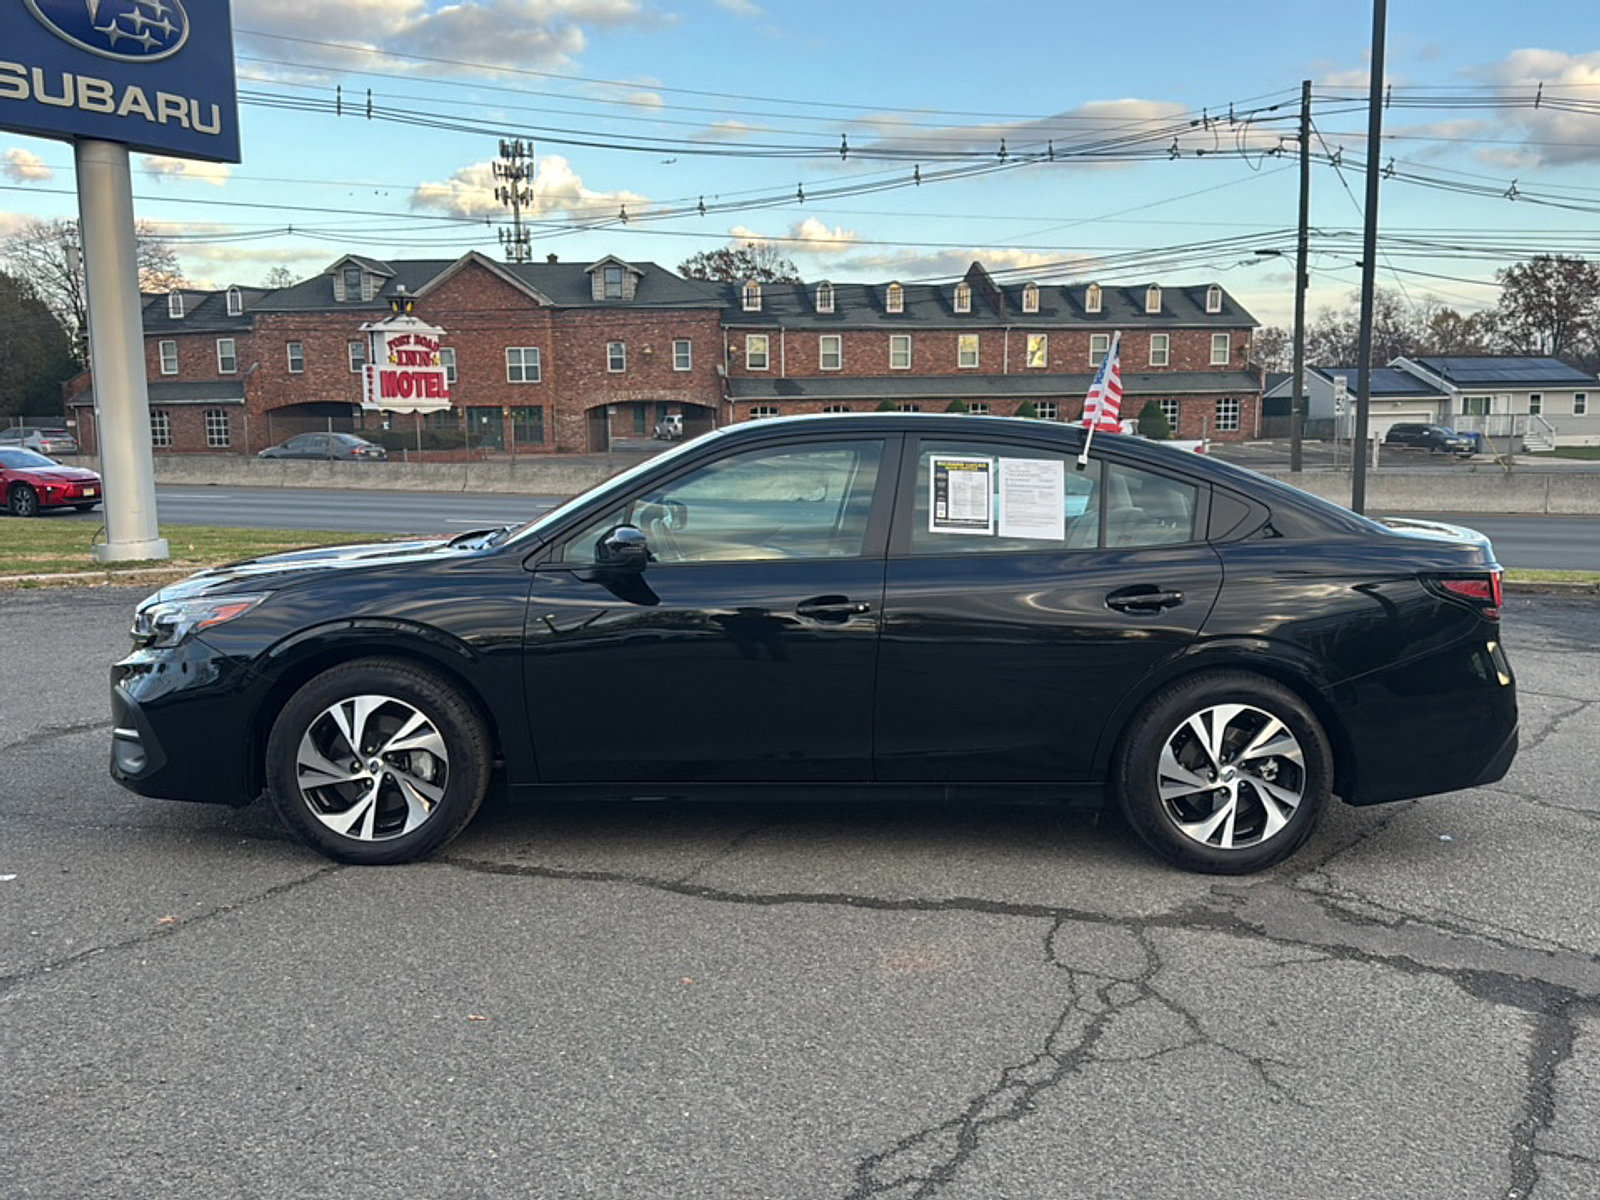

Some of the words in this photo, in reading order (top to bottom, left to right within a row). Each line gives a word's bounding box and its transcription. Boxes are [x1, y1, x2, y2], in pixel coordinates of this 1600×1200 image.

[0, 60, 222, 135] SUBARU
[396, 350, 432, 367] INN
[380, 370, 451, 398] MOTEL
